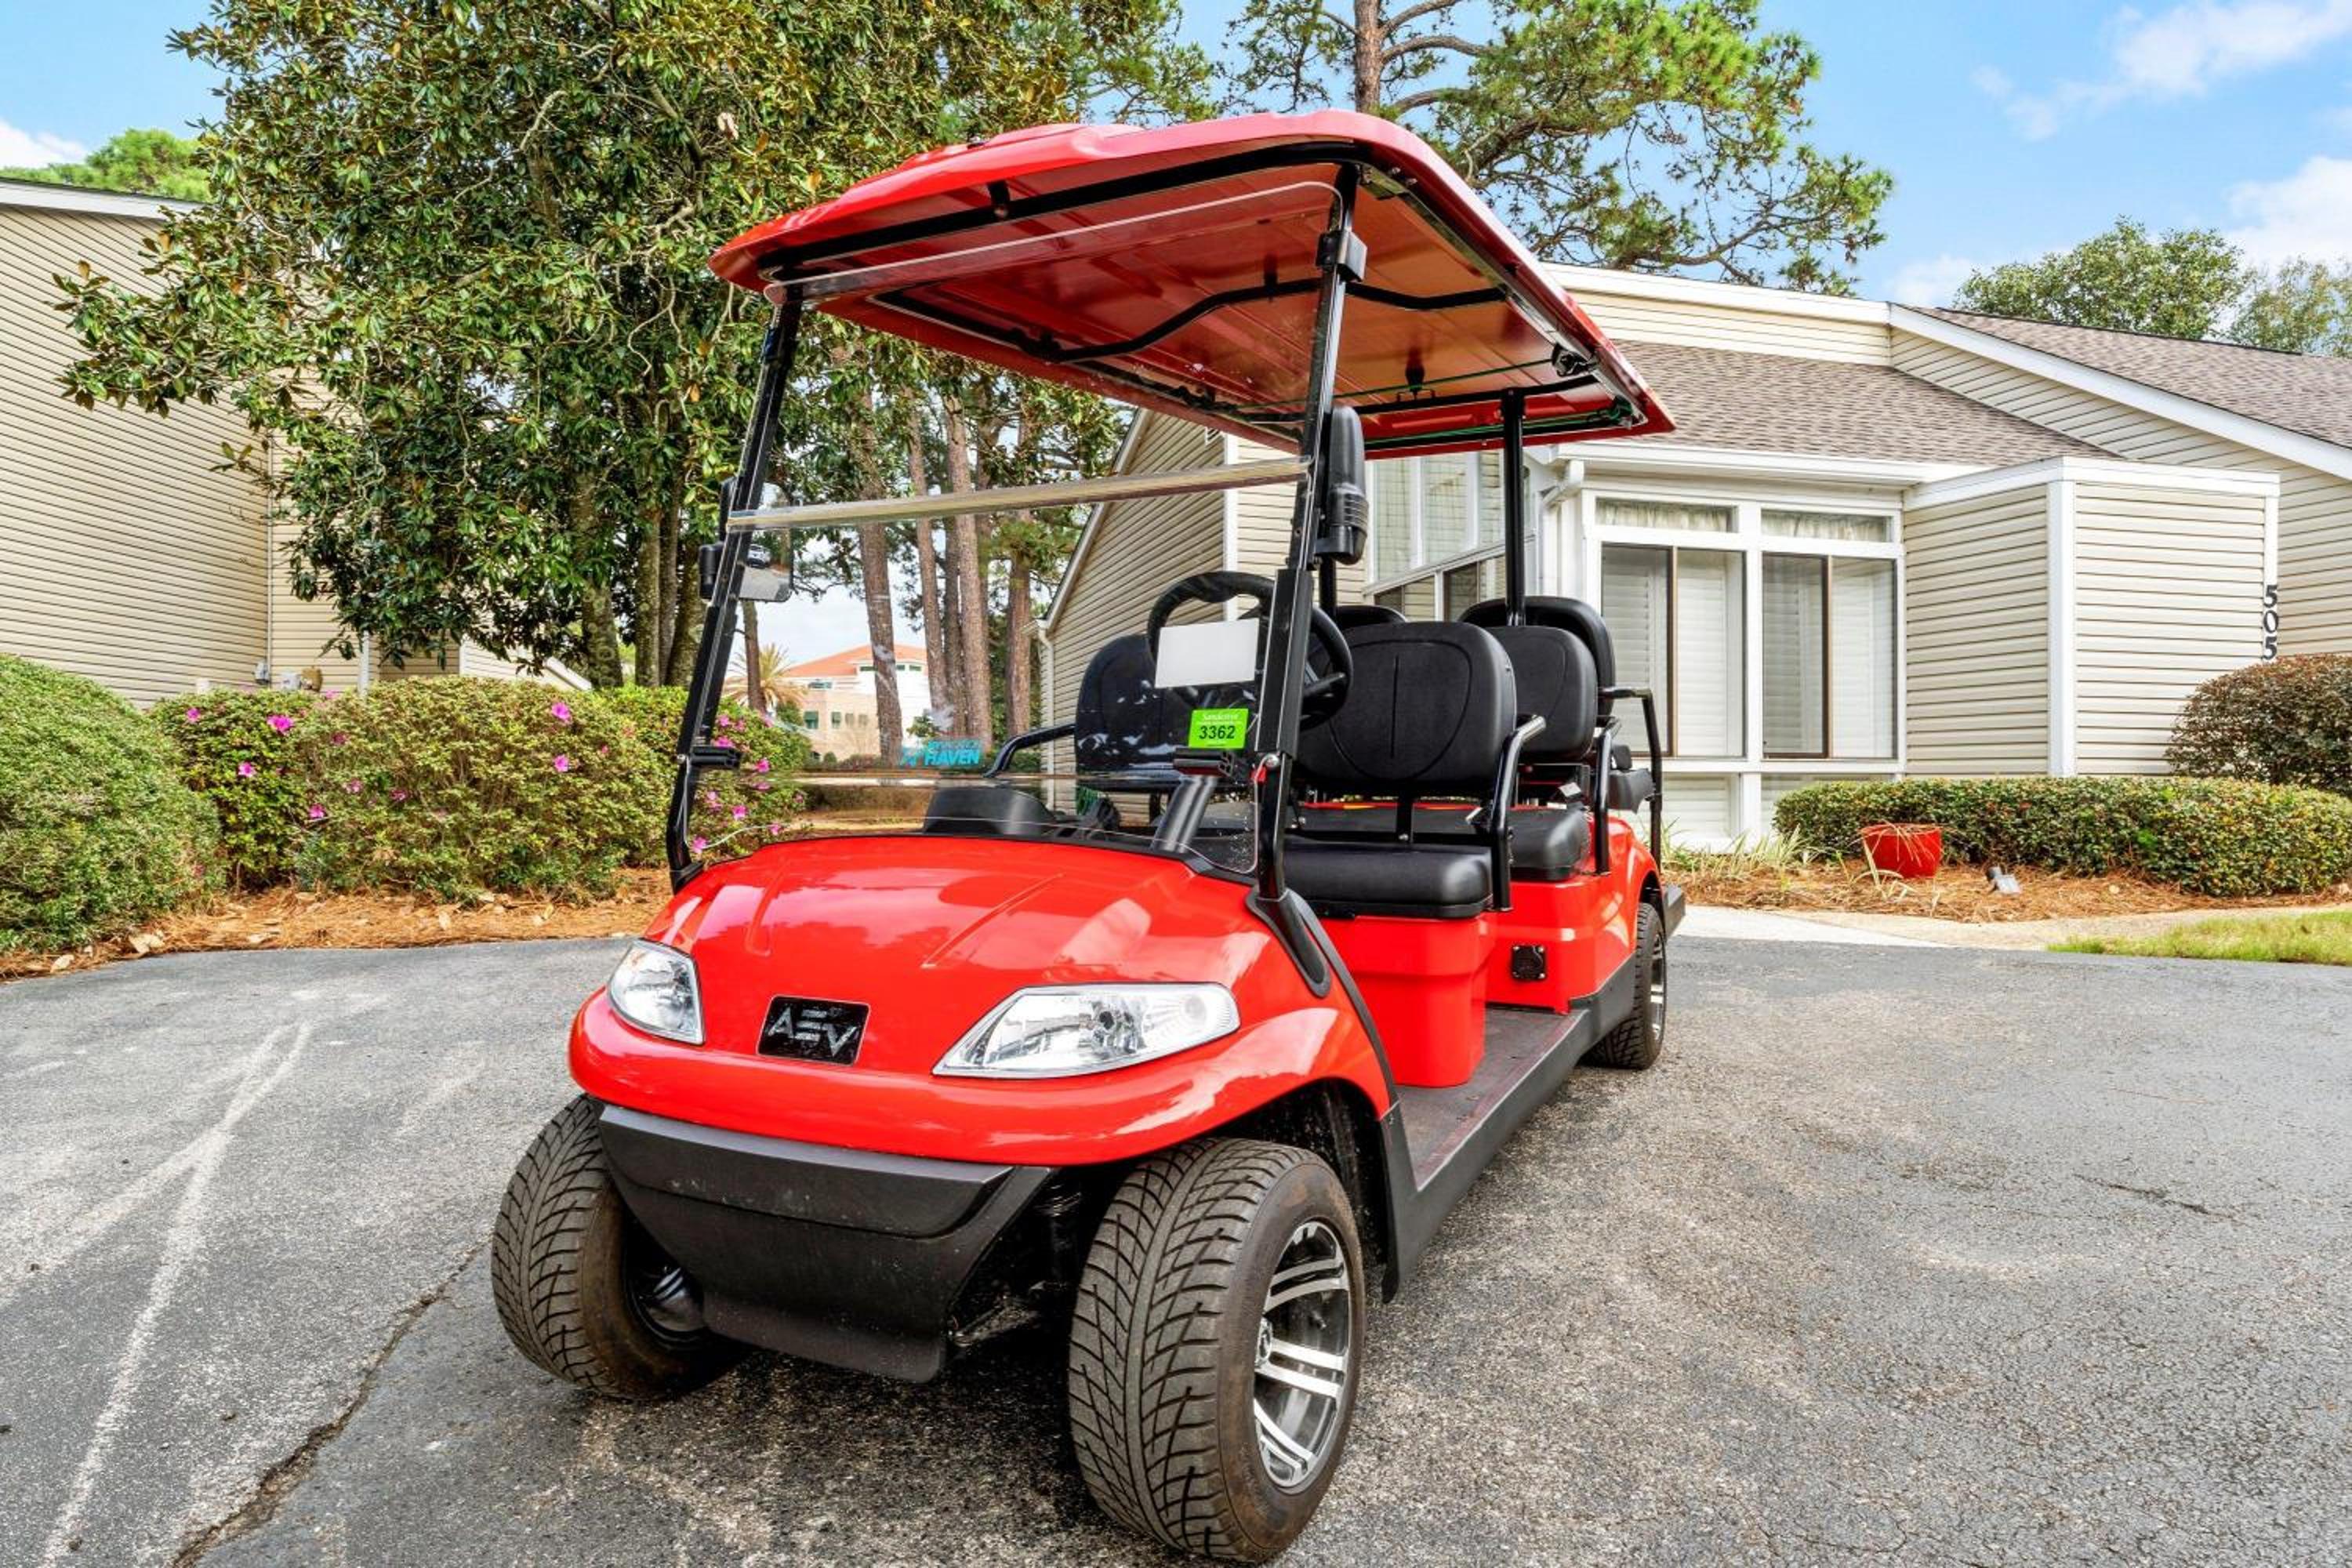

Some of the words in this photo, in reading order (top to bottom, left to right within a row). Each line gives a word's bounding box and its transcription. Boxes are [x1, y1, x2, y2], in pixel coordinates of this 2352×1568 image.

[2263, 585, 2278, 660] 505
[1199, 725, 1236, 739] 3362
[924, 750, 980, 766] HAVEN
[768, 1007, 857, 1057] AEV
